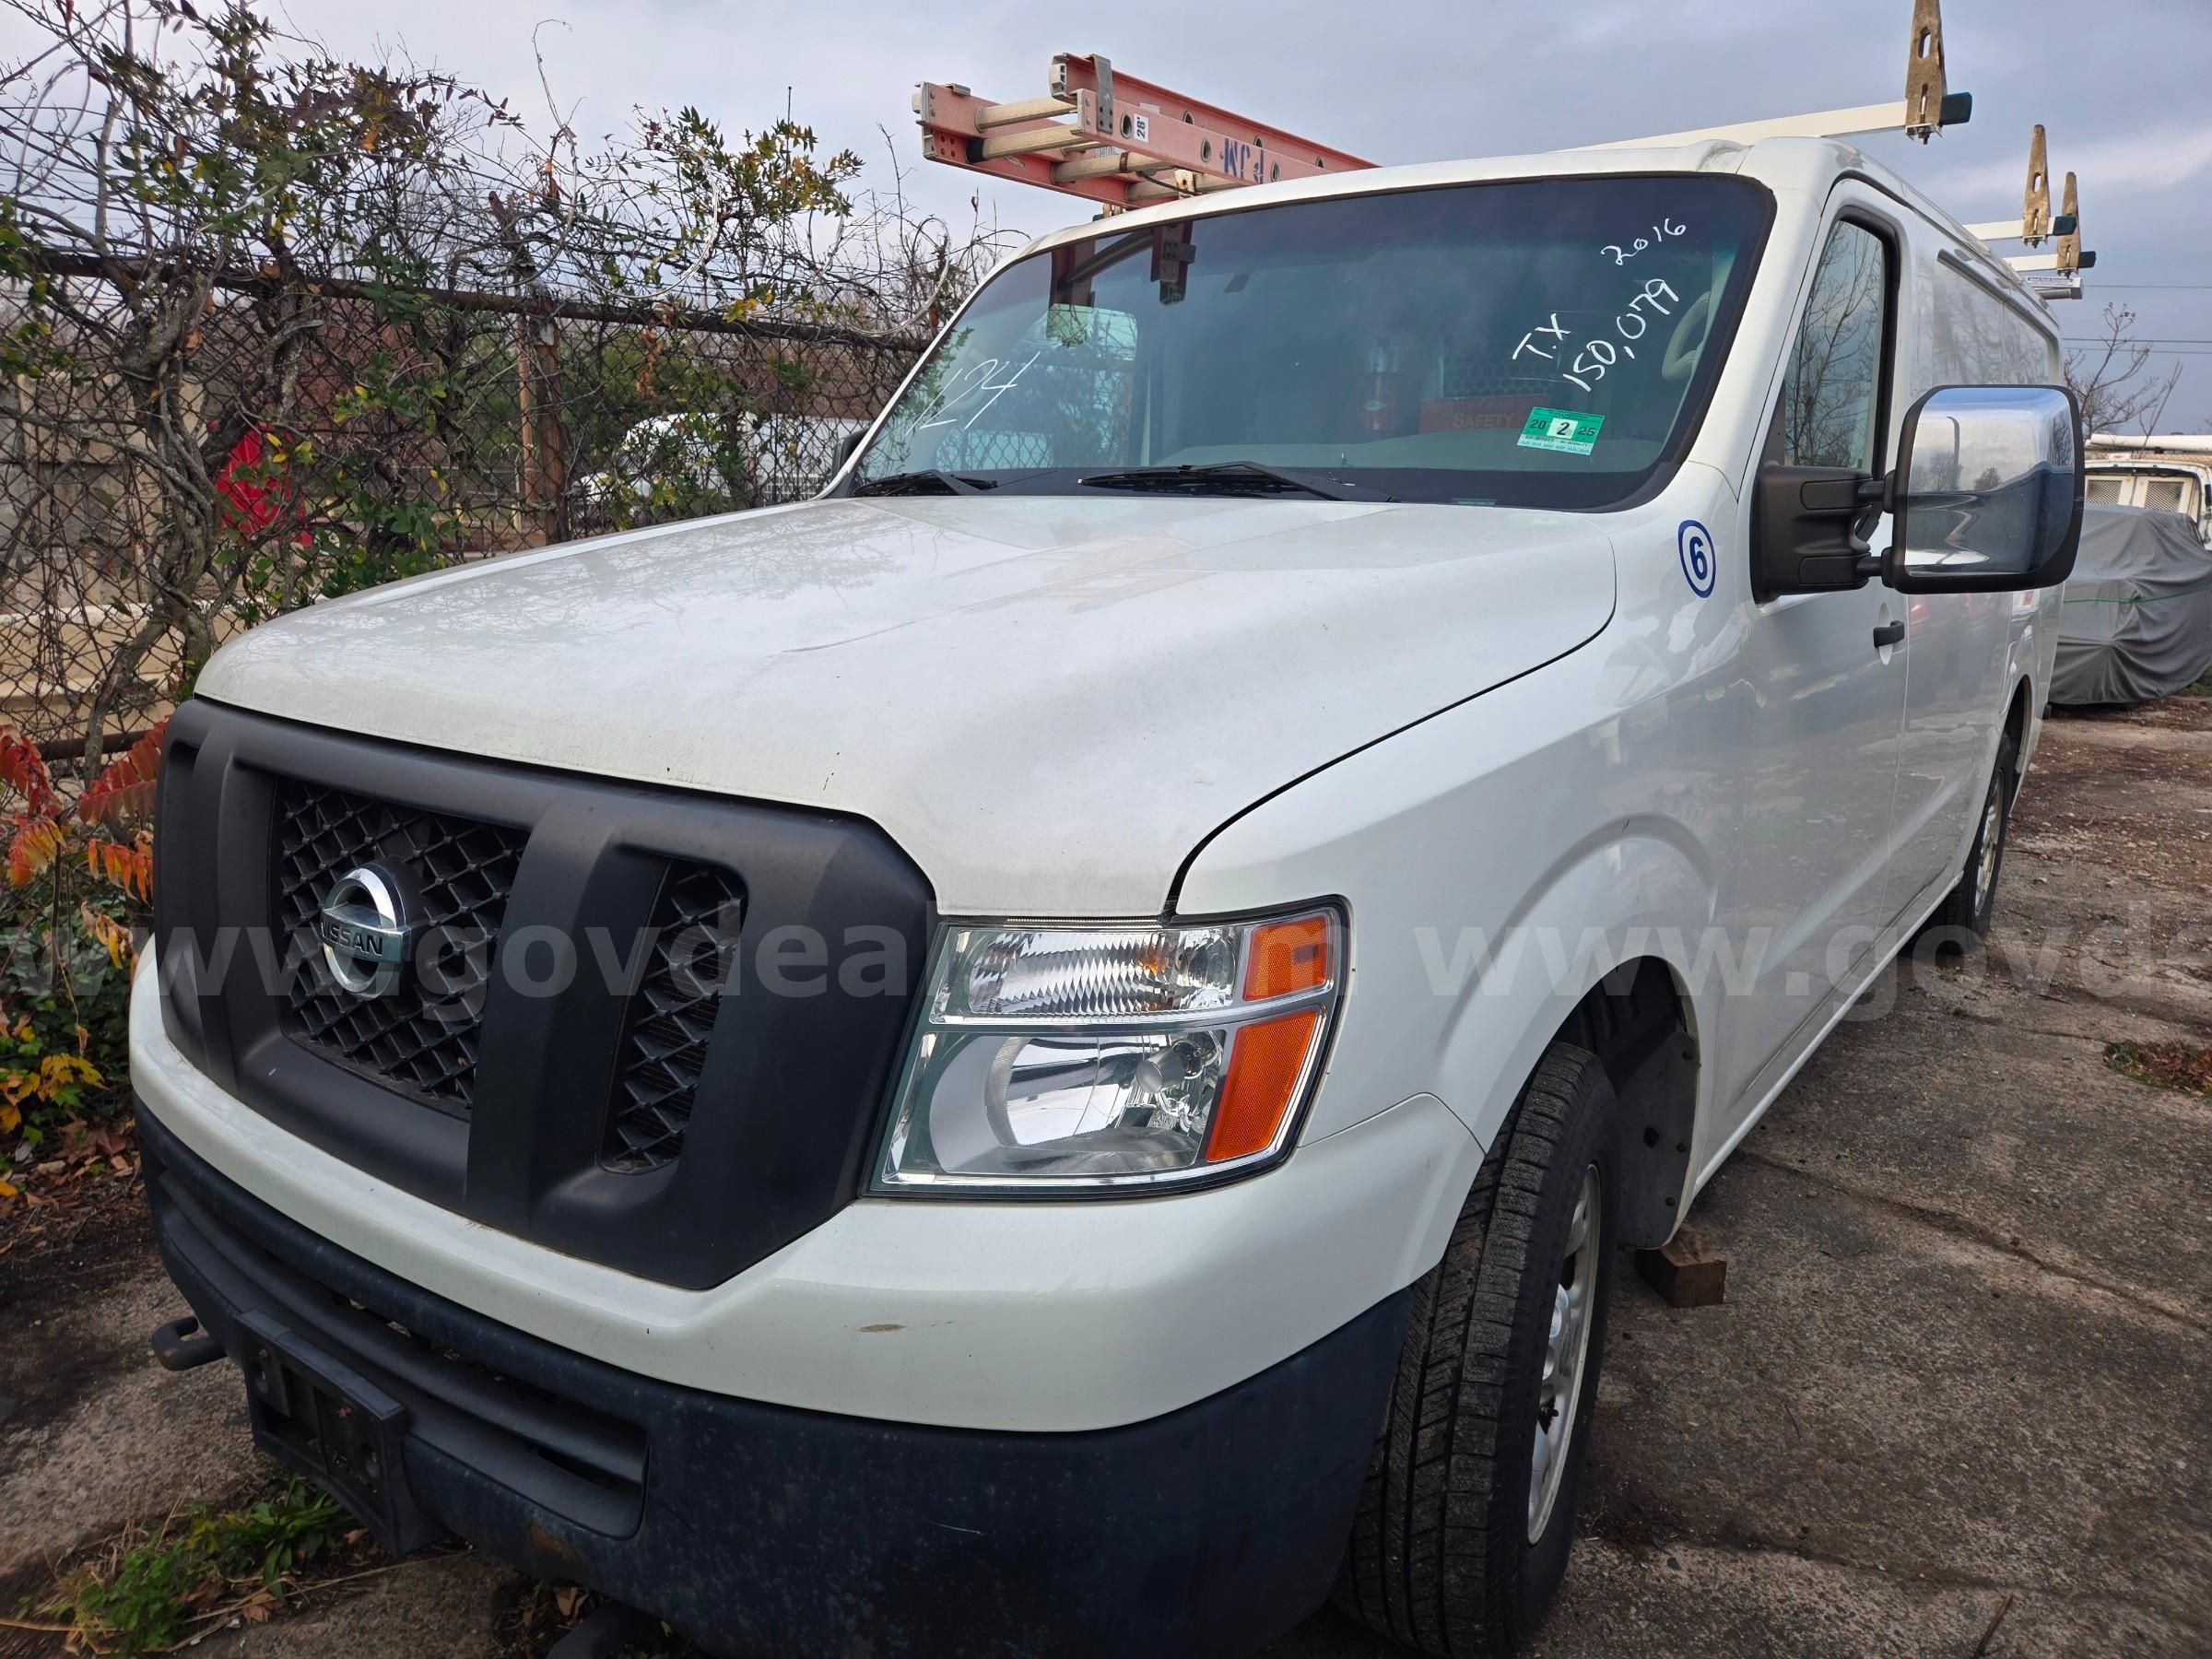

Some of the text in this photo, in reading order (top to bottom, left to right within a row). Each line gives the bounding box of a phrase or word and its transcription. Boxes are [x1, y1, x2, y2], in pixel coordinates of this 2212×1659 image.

[1600, 218, 1687, 265] 2016
[1562, 278, 1680, 393] 150,079
[1452, 412, 1514, 429] SAFETY
[1530, 418, 1596, 437] 20 2 25
[1688, 535, 1708, 581] 6
[321, 922, 384, 957] NISSAN
